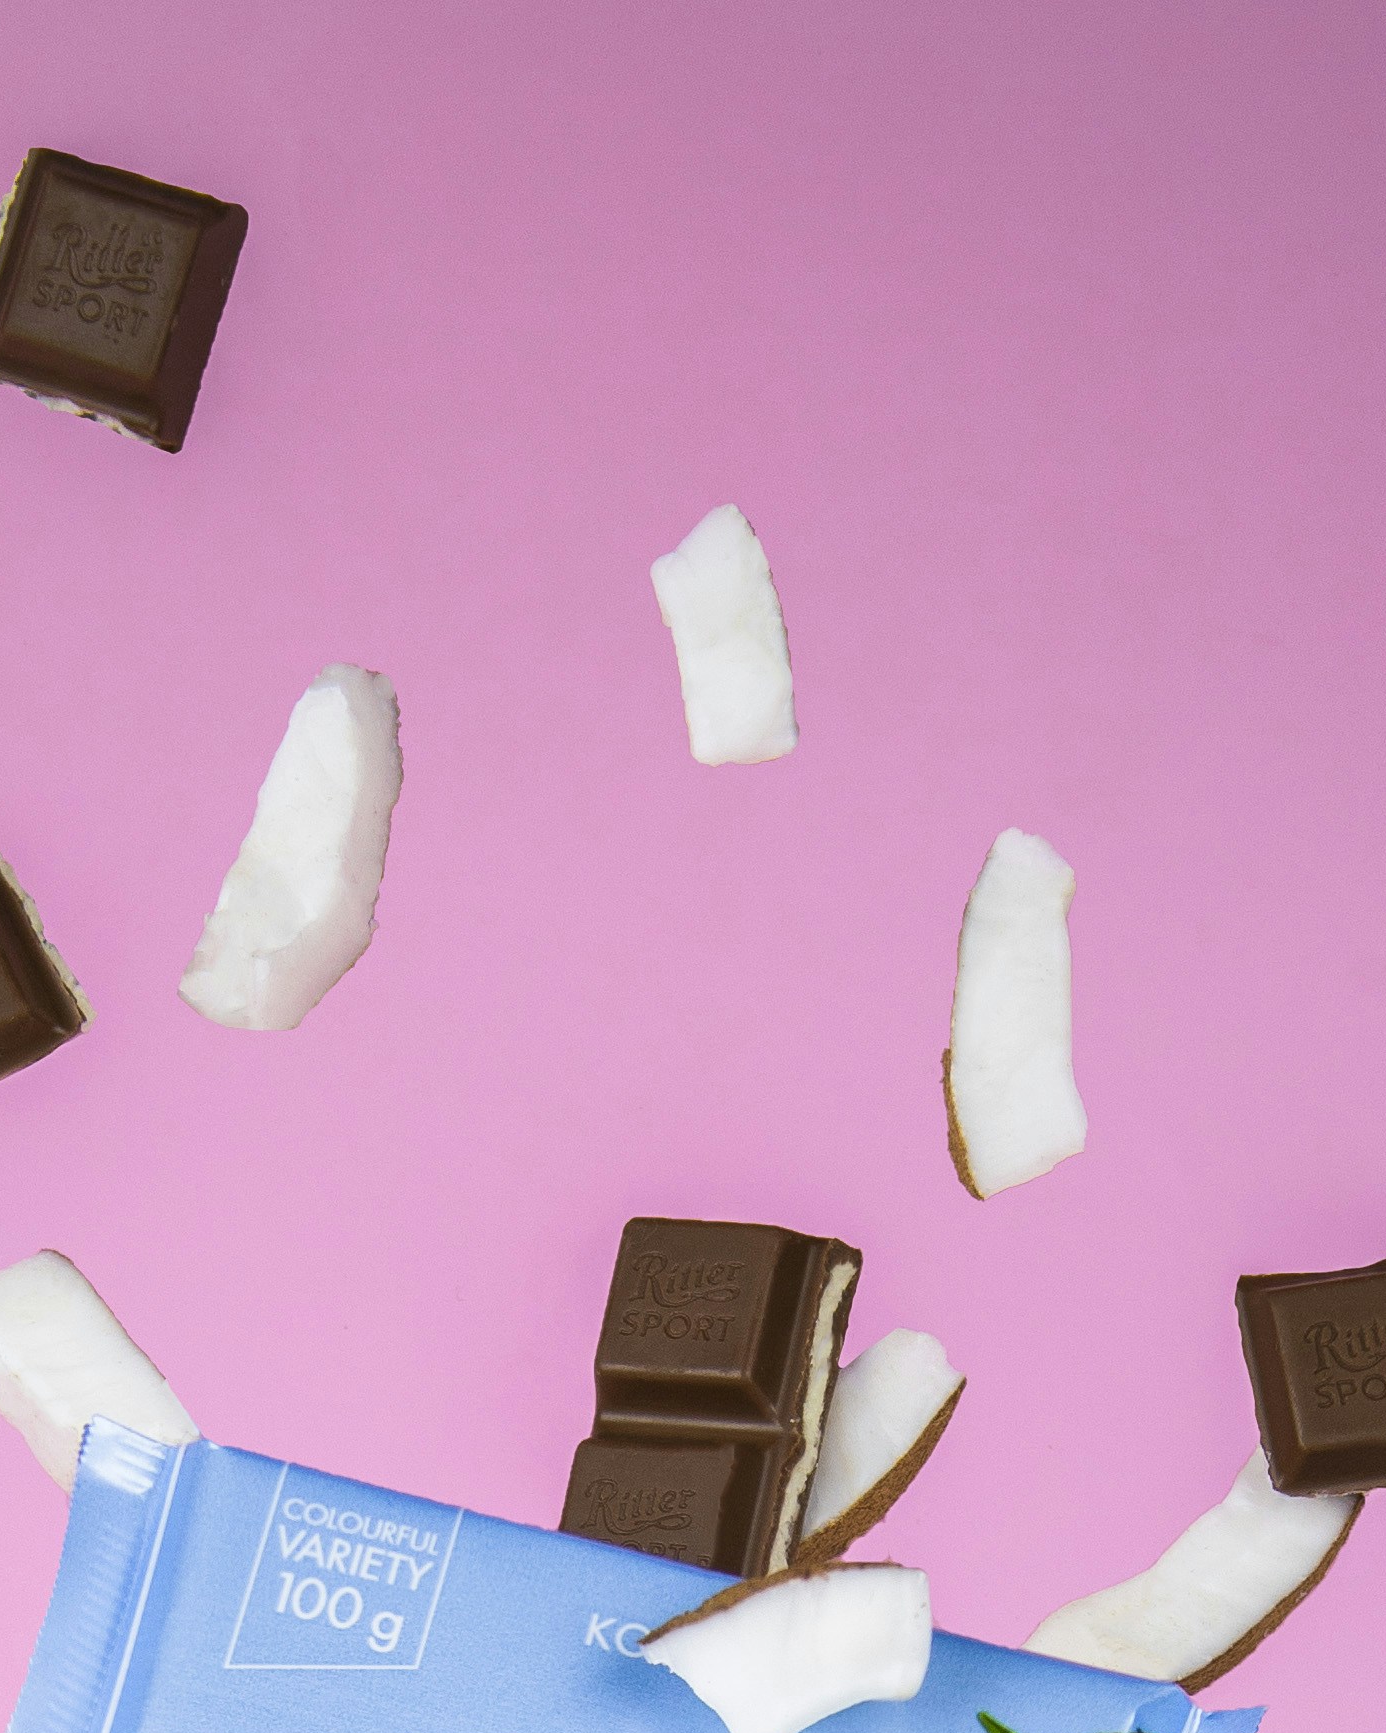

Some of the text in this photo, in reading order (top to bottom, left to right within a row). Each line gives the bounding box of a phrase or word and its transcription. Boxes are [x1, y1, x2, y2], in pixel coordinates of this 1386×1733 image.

[43, 221, 164, 294] Ritter
[32, 277, 150, 338] SPORT
[627, 1251, 745, 1308] Ritter
[619, 1309, 735, 1342] SPORT
[282, 1497, 439, 1557] COLOURFUL
[580, 1478, 696, 1536] Ritter
[278, 1523, 435, 1591] VARIETY
[276, 1570, 404, 1653] 100 g
